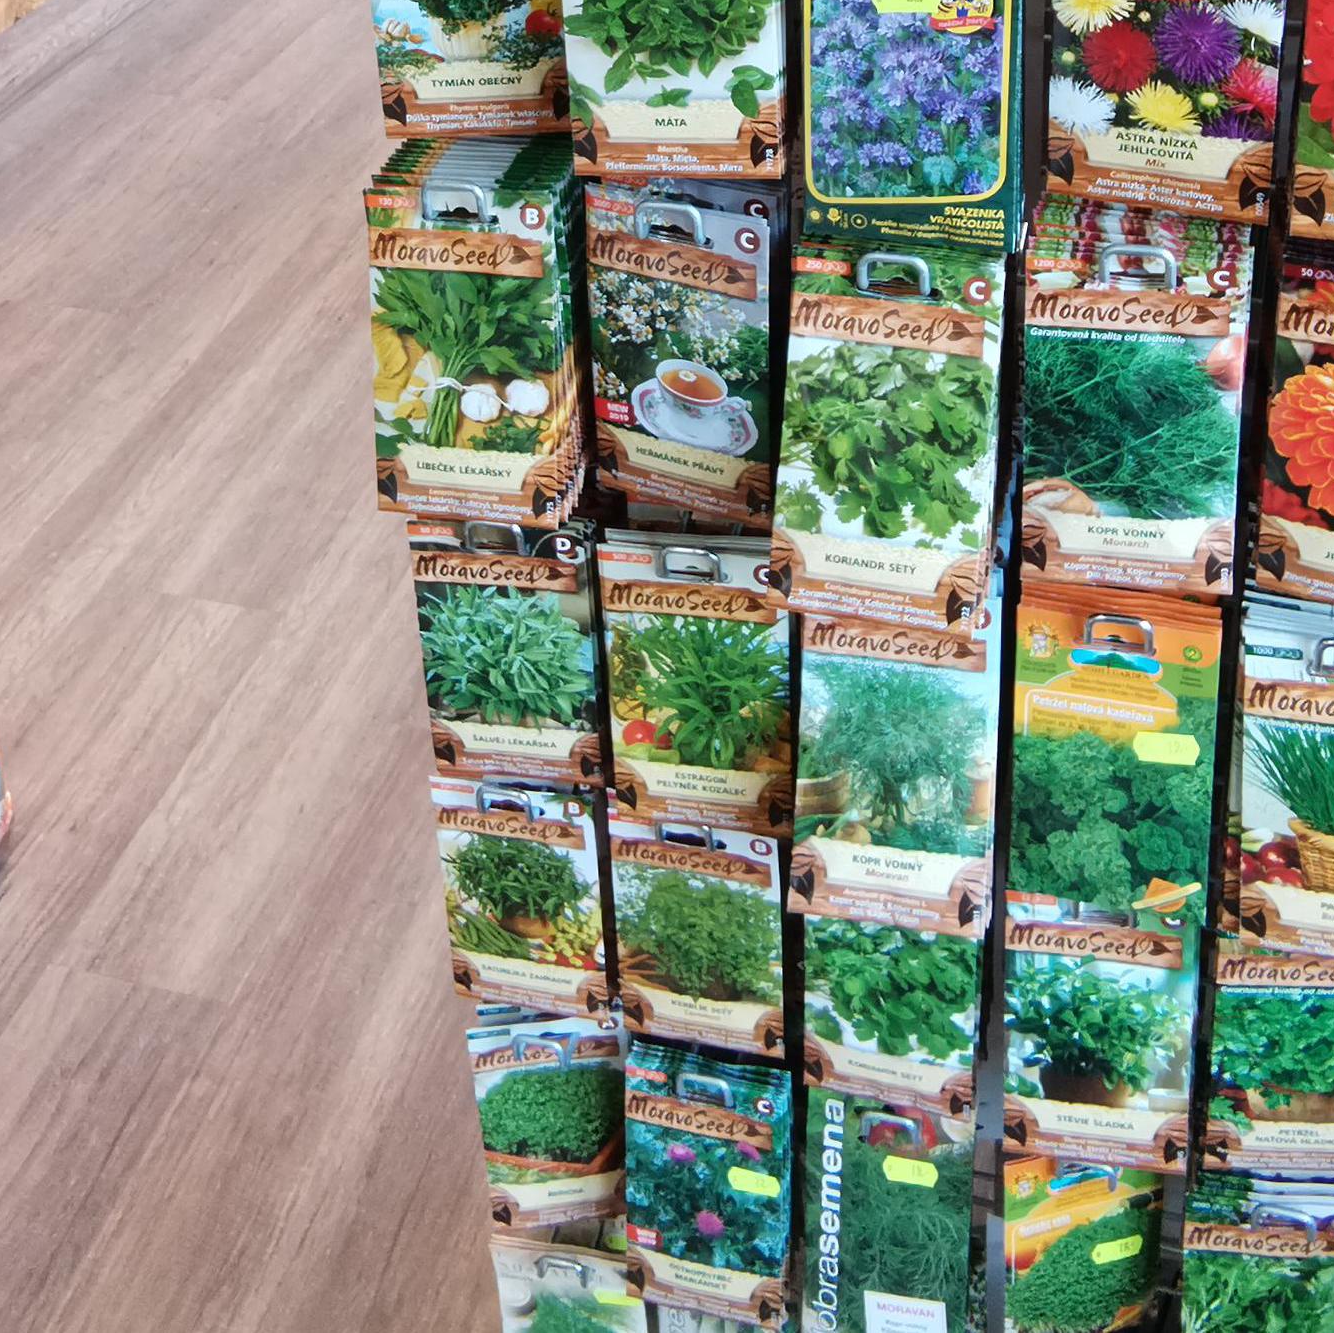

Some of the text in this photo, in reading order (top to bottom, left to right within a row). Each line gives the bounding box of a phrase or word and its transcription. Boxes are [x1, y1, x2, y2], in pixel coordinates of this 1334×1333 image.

[431, 72, 523, 89] TYMIÁN OBECNÝ
[1115, 129, 1199, 151] ASTRA NÍZKÁ
[1118, 141, 1194, 162] JEHLICOVITÁ
[1145, 156, 1167, 169] Mix
[373, 233, 505, 268] MoravoSeed
[591, 235, 713, 282] MoravoSeed
[1030, 293, 1184, 328] MoravoSeed
[796, 299, 942, 344] MoravoSeed
[606, 401, 630, 413] NEW
[417, 460, 456, 475] LIBEČEK
[1087, 525, 1120, 538] KOPR
[1102, 537, 1149, 550] Monarch
[825, 553, 886, 571] KORIANDR
[852, 853, 881, 866] KOPR
[877, 1302, 935, 1319] MORAVAN
